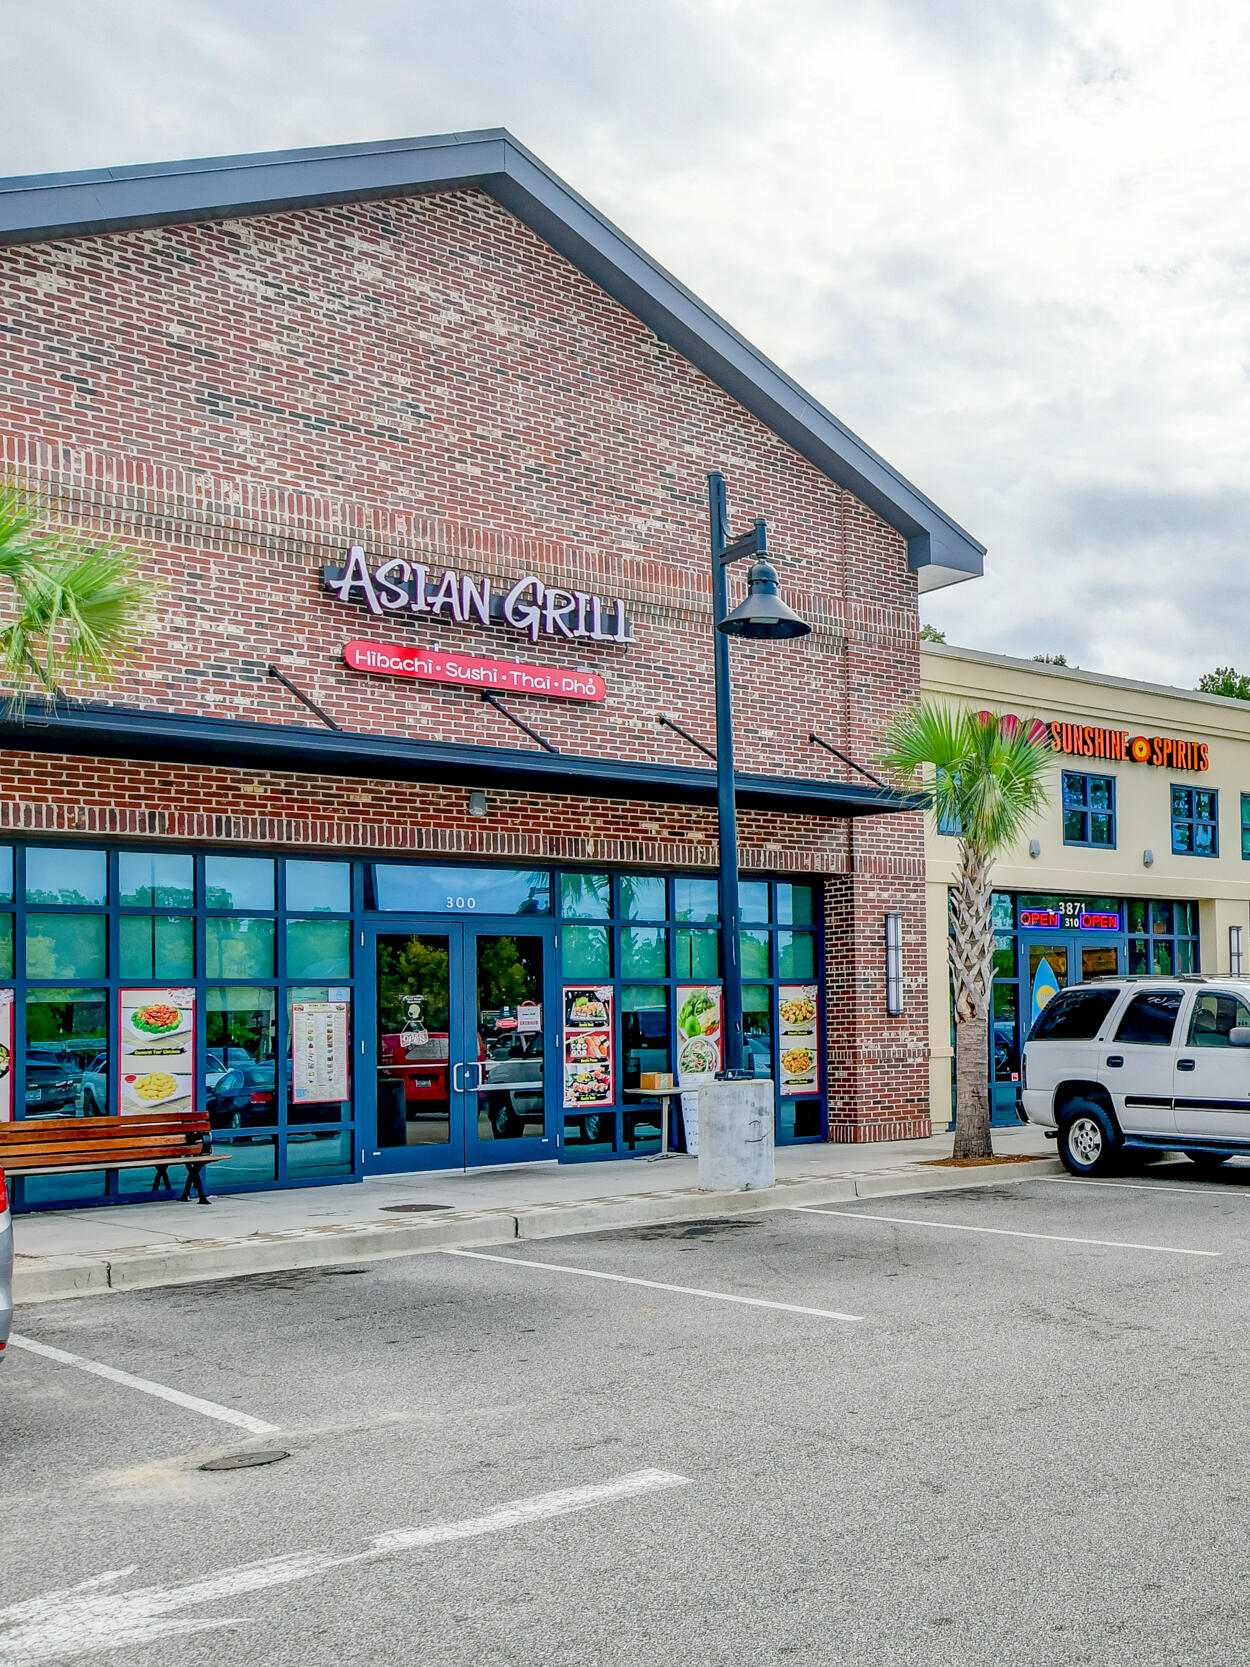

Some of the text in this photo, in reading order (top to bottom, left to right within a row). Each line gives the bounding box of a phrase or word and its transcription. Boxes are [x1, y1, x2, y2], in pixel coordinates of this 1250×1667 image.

[328, 546, 637, 643] ASIAN GRILL
[355, 649, 433, 675] Hibachi
[445, 661, 498, 684] Sushi
[509, 670, 551, 690] Thai
[1050, 720, 1208, 771] SUNSHINE SPIRITS
[446, 896, 476, 909] 300
[1059, 902, 1086, 915] 3871
[1021, 912, 1057, 926] OPEN
[1065, 918, 1079, 927] 310
[1083, 915, 1117, 928] OPEN
